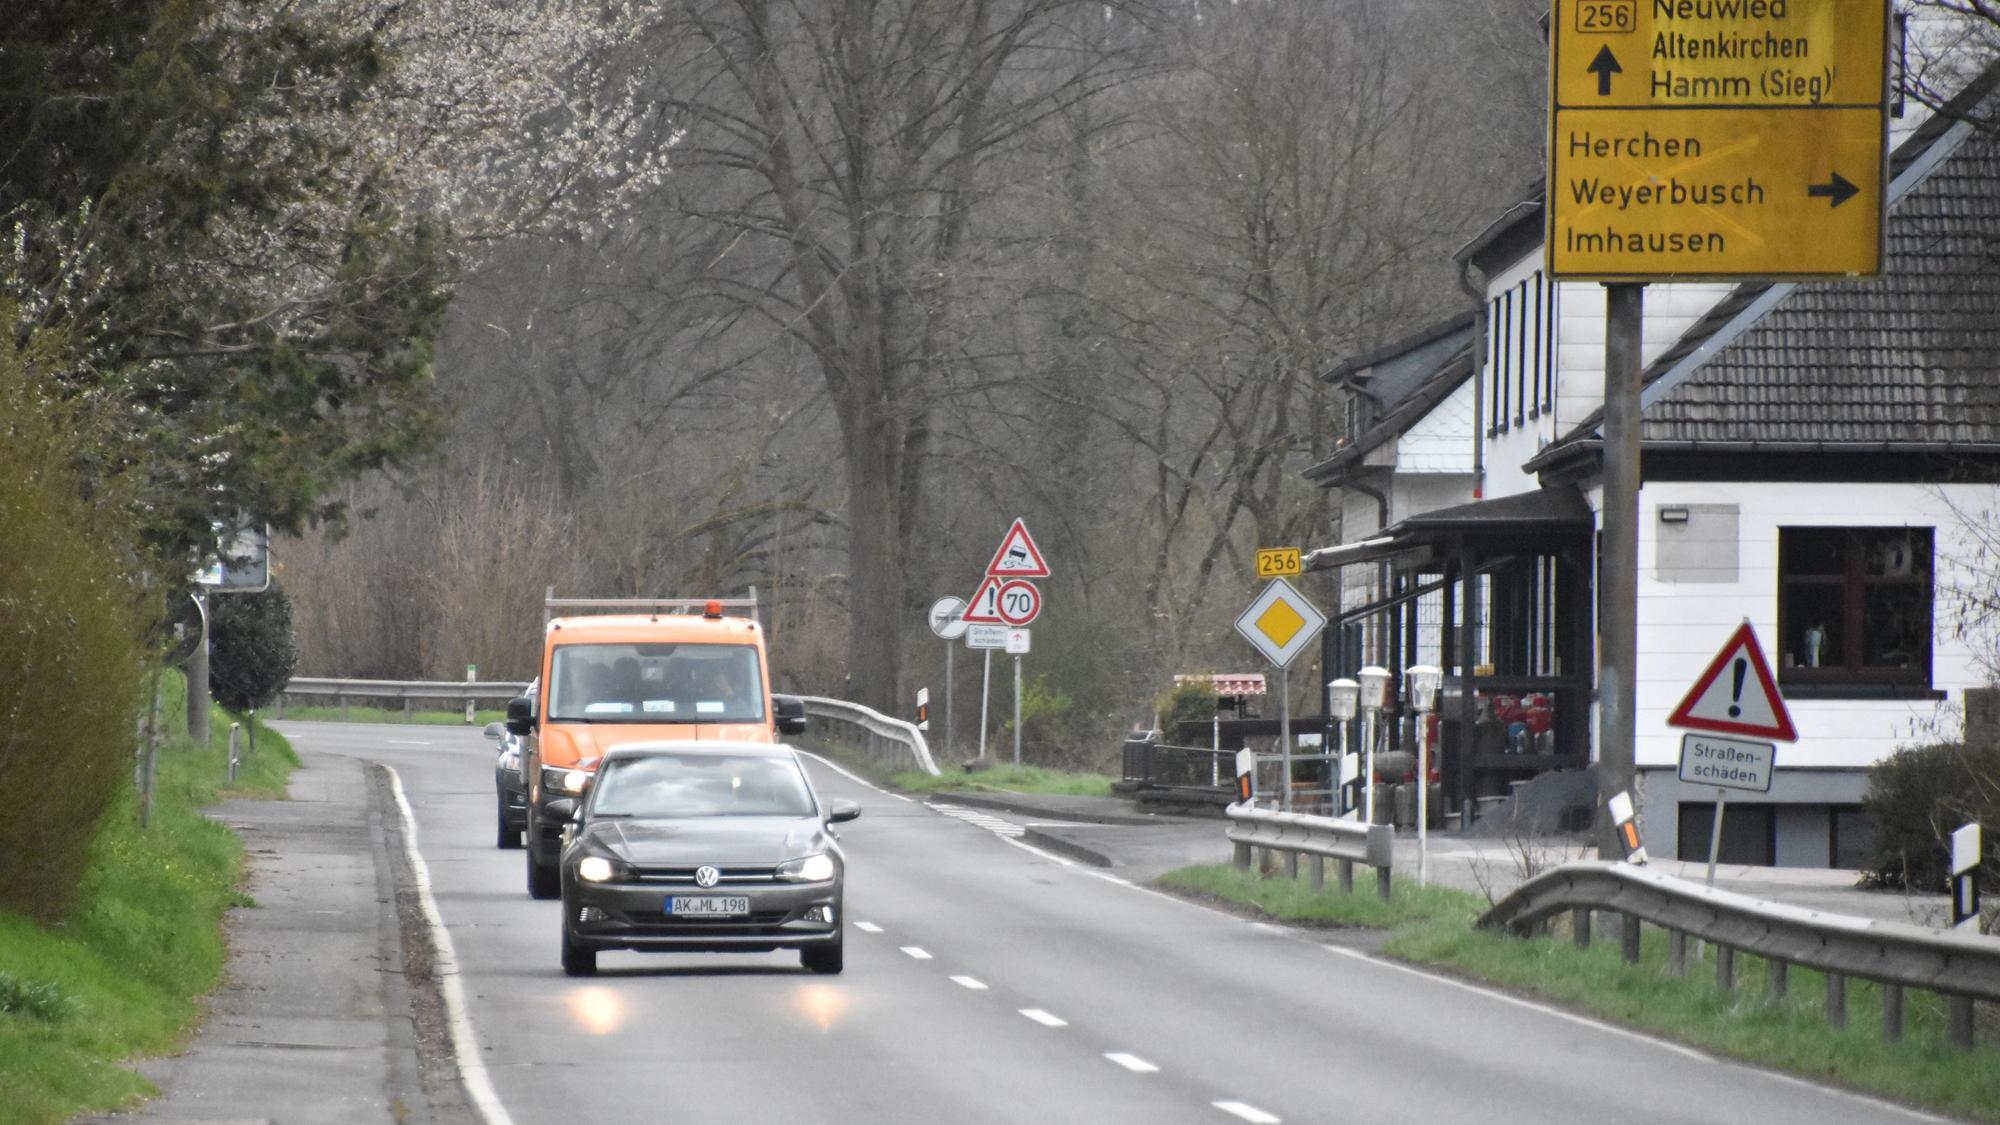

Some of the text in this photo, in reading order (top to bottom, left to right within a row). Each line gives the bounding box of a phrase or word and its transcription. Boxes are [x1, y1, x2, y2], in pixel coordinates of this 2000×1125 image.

[1582, 4, 1630, 28] 256
[1652, 0, 1787, 20] Neuwied
[1652, 30, 1809, 59] Altenkirchen
[1650, 65, 1832, 104] Hamm (Sieg)
[1569, 130, 1702, 158] Herchen
[1570, 177, 1765, 211] Weyerbusch
[1566, 225, 1726, 253] Imhausen
[1261, 553, 1296, 572] 256
[1006, 593, 1031, 613] 70
[1694, 743, 1761, 763] Straßen-
[1694, 763, 1758, 783] schäden
[720, 898, 747, 913] 198
